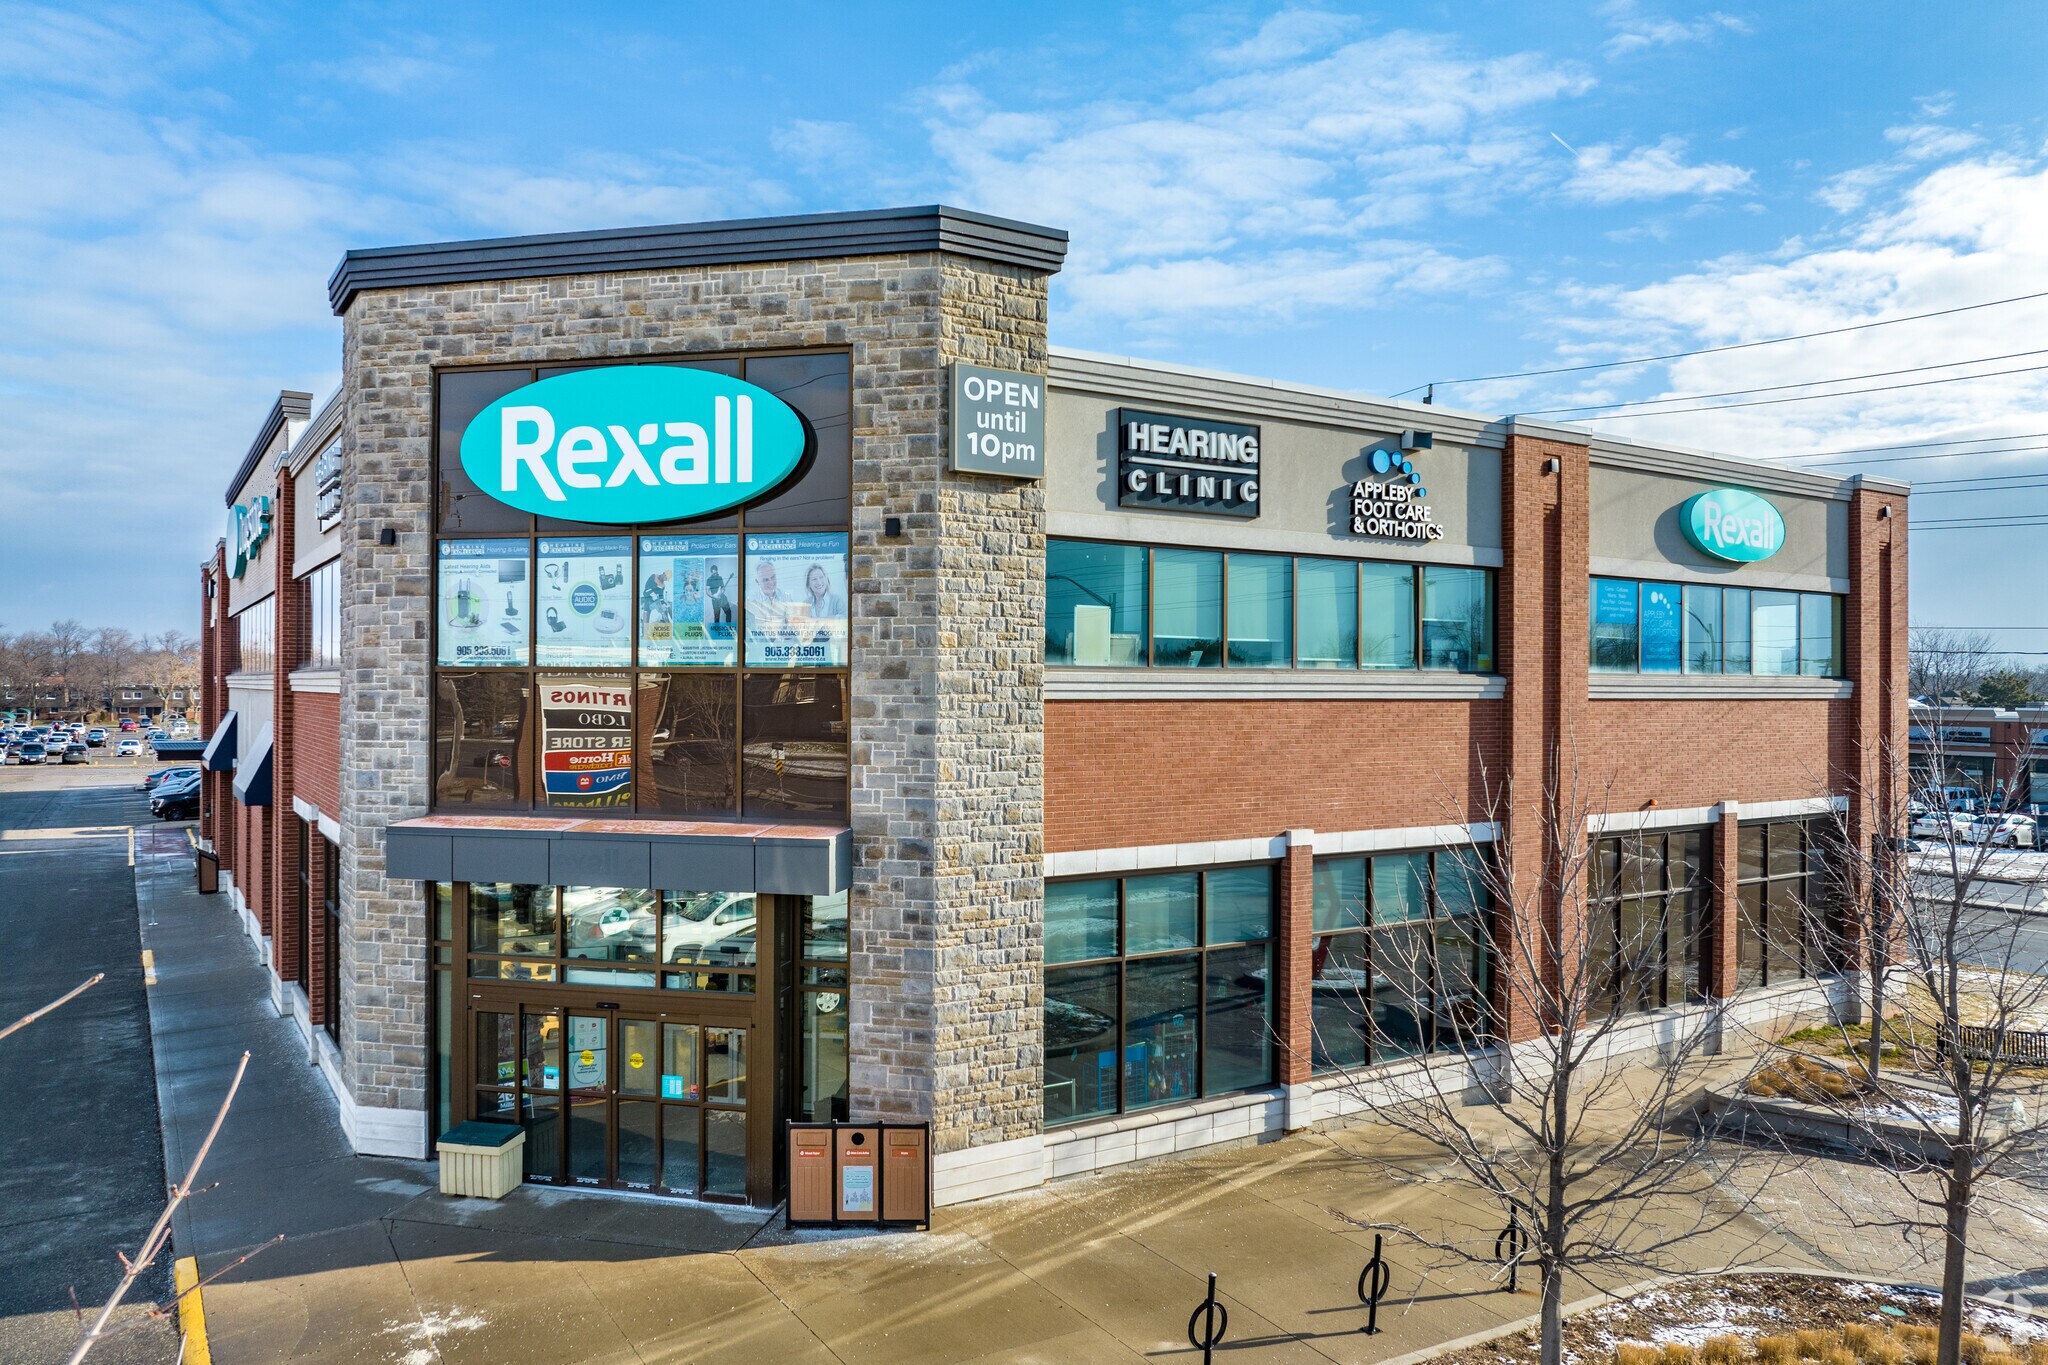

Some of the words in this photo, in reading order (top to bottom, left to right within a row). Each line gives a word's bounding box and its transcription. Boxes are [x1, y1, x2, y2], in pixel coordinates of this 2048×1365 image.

[964, 376, 1038, 409] OPEN
[977, 411, 1026, 433] until
[501, 395, 752, 501] Rexall
[967, 432, 1035, 463] 10pm
[1128, 422, 1258, 463] HEARING
[1128, 469, 1258, 502] CLINIC
[1353, 481, 1414, 502] APPLEBY
[1354, 499, 1393, 518] FOOT
[1395, 503, 1431, 521] CARE
[1353, 516, 1366, 534] &
[1366, 518, 1444, 540] ORTHOTICS
[1704, 502, 1774, 549] Rexall
[1644, 610, 1665, 618] APPLEBY
[1659, 620, 1673, 628] CARE
[765, 647, 825, 656] 905.333.5061
